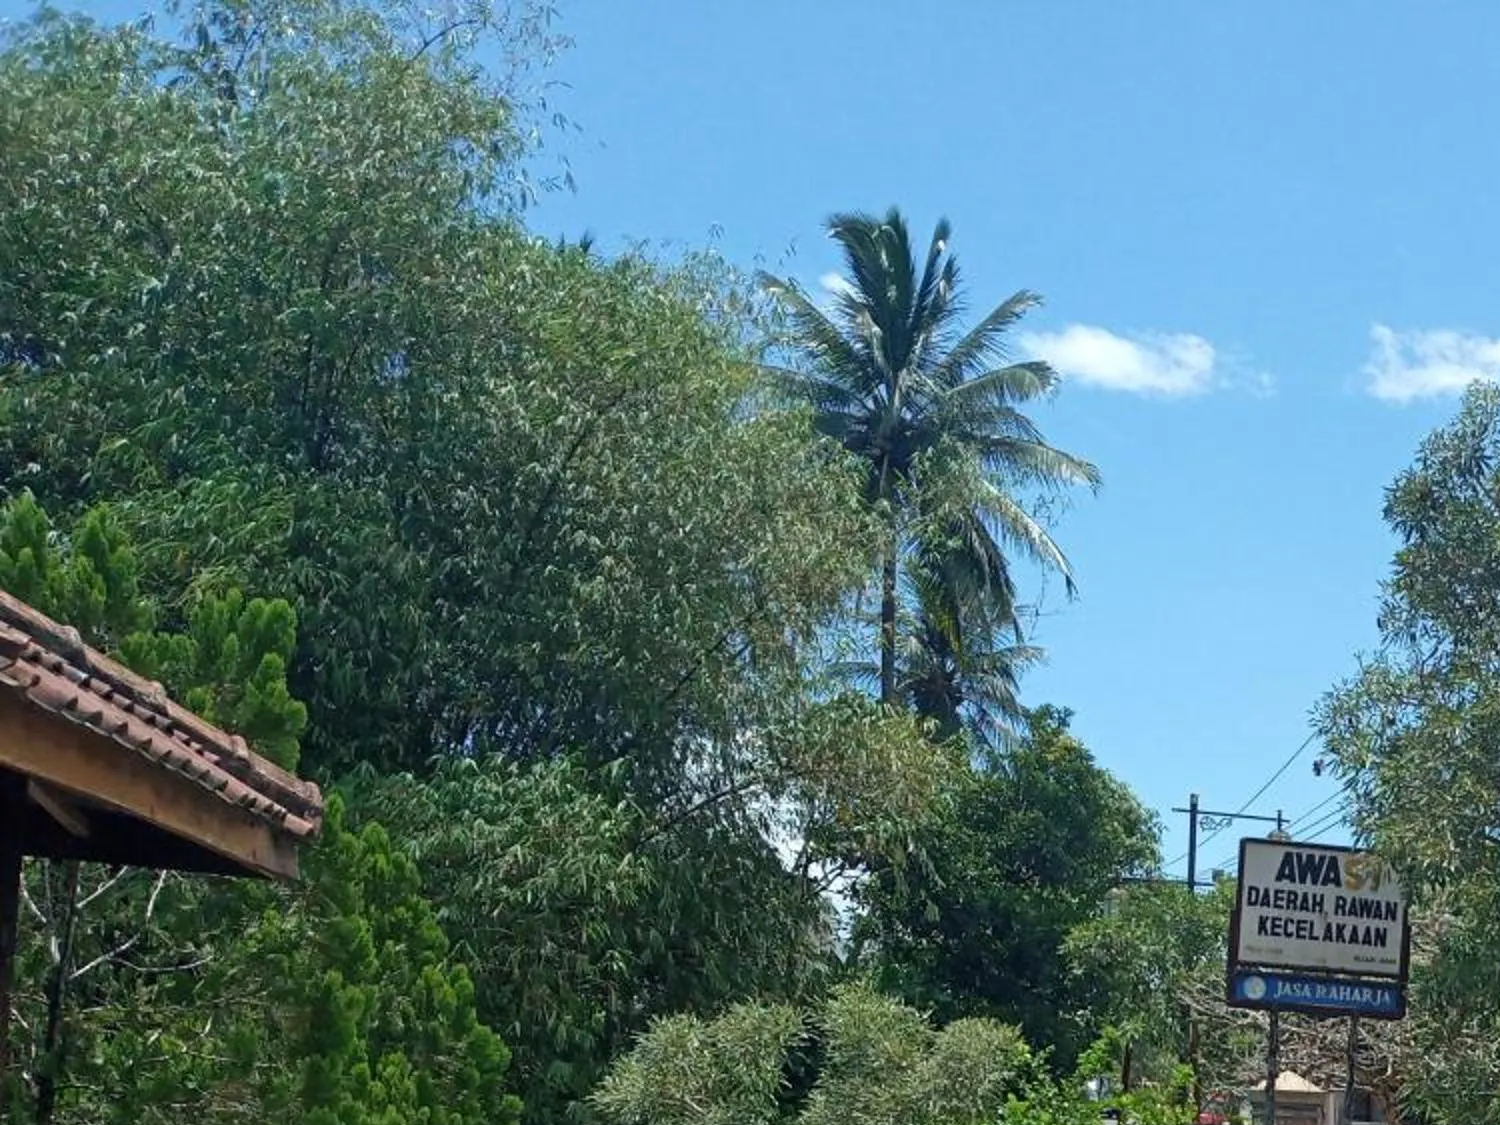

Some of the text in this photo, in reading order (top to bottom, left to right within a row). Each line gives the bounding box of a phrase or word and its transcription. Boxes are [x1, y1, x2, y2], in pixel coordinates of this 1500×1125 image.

[1247, 885, 1398, 922] DAERAH RAWAN
[1257, 915, 1388, 948] KECELAKAAN
[1274, 981, 1391, 1004] JASA RAHARJA
